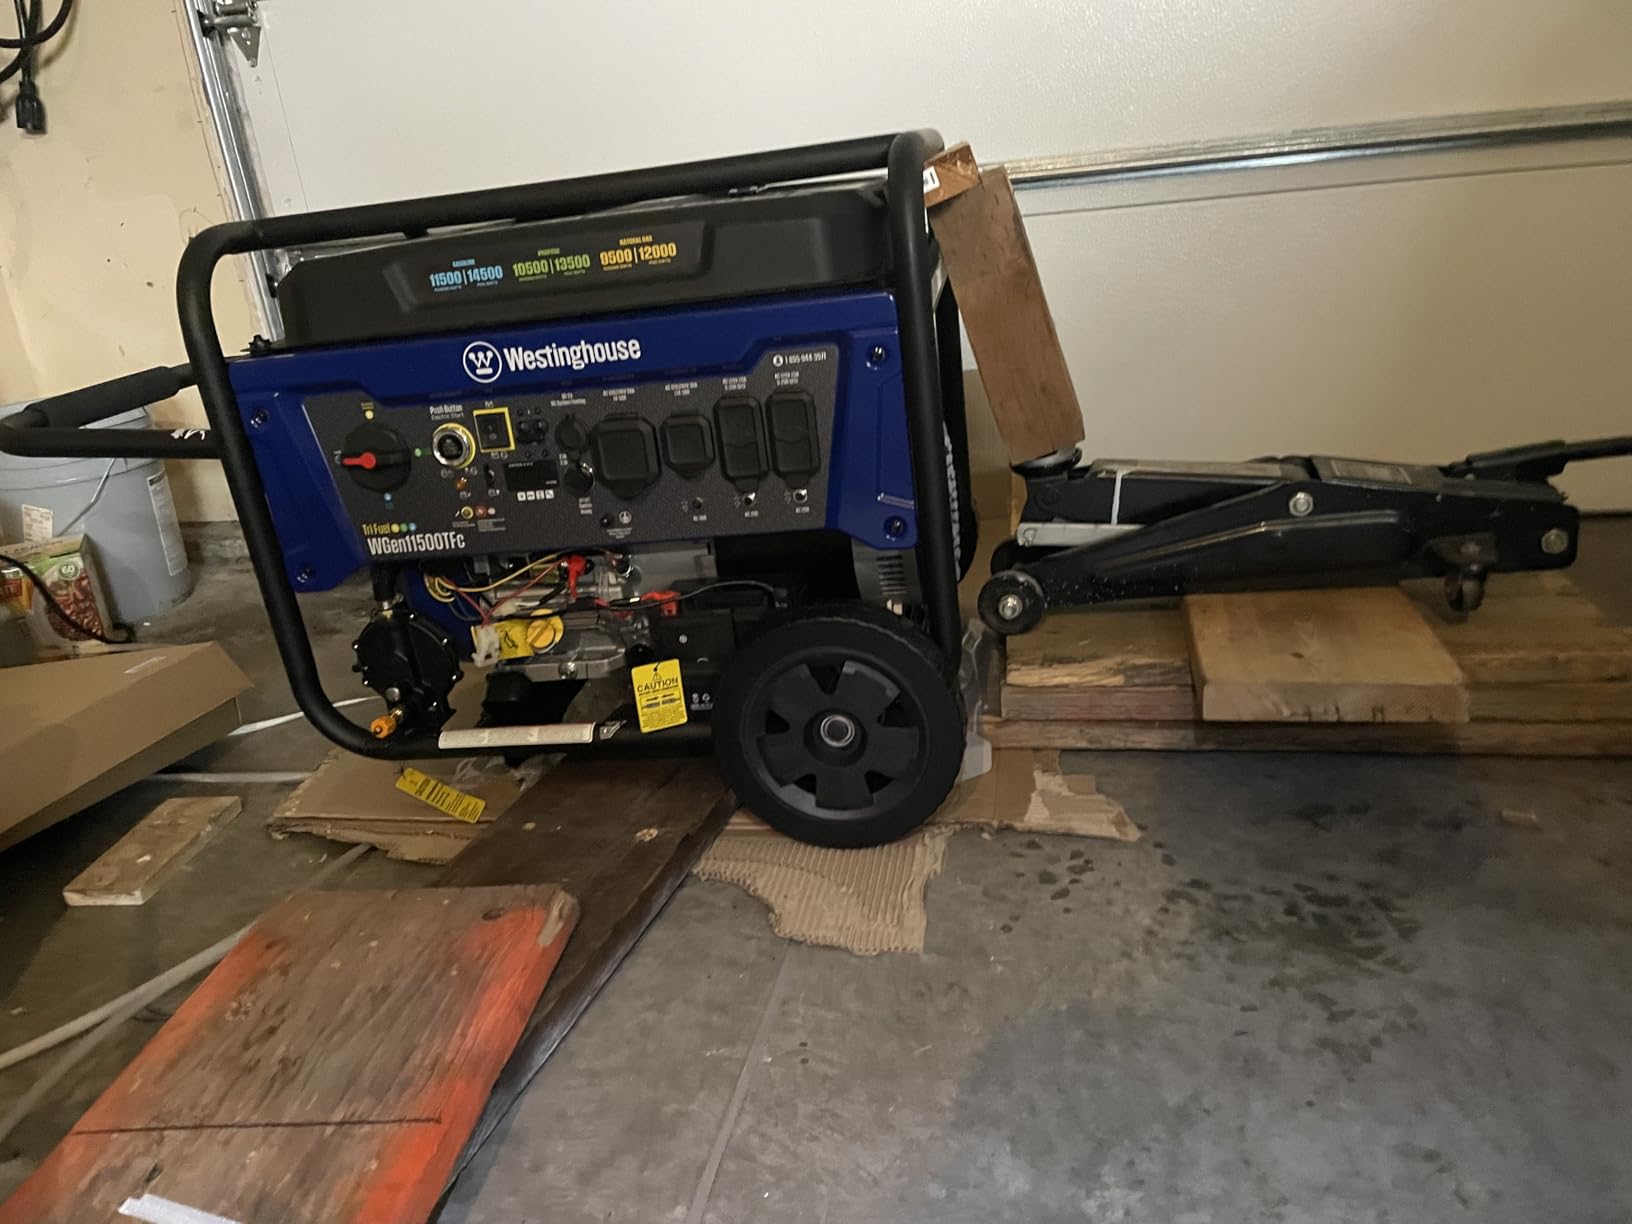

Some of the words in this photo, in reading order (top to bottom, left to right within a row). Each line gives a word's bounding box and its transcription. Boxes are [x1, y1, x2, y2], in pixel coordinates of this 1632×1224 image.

[639, 242, 677, 261] 12000
[429, 271, 463, 287] 11500
[467, 265, 503, 283] 14500
[512, 259, 548, 277] 10500
[554, 254, 591, 271] 13500
[503, 338, 641, 372] Westinghouse
[367, 531, 466, 555] WGen11500TFc
[637, 676, 678, 693] CAUTION
